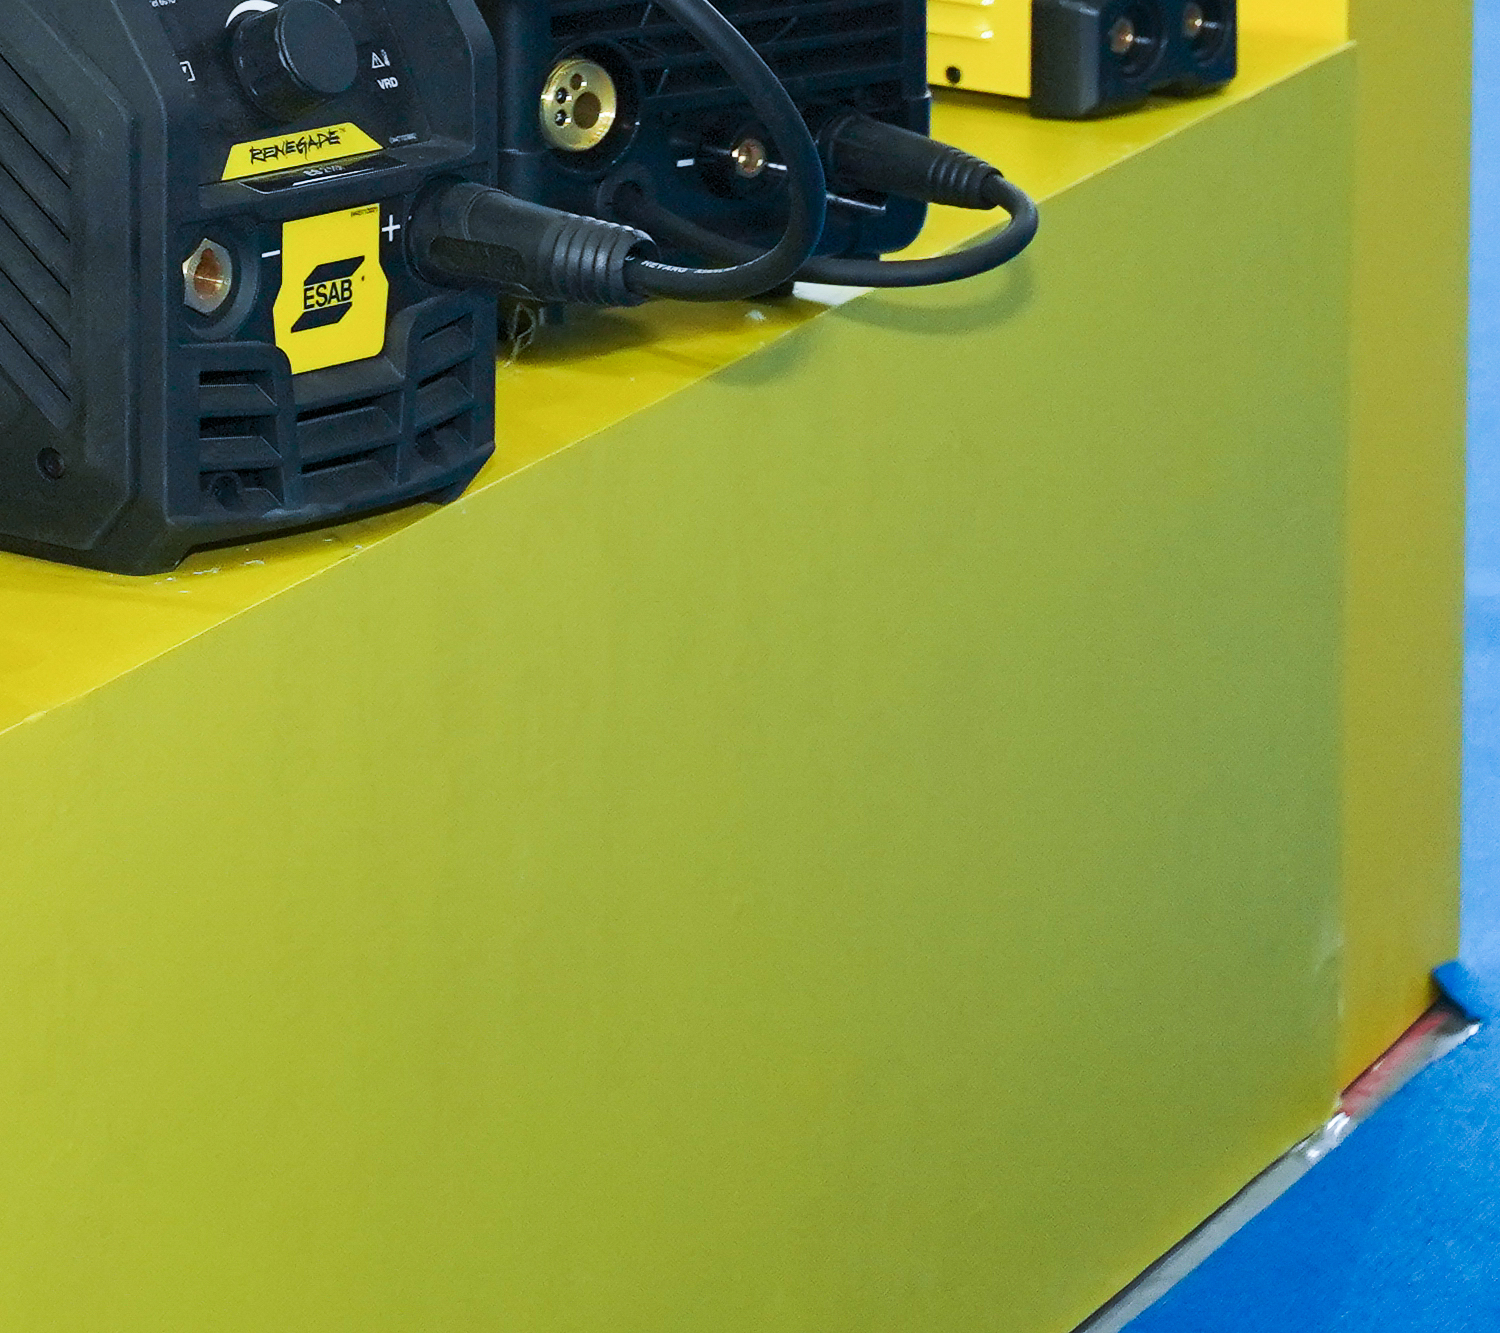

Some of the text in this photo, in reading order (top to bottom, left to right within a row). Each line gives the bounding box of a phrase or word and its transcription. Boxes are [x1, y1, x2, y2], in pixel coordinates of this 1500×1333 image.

[376, 75, 399, 91] VRD
[249, 129, 342, 165] RENEGADE
[302, 279, 354, 312] ESAB
